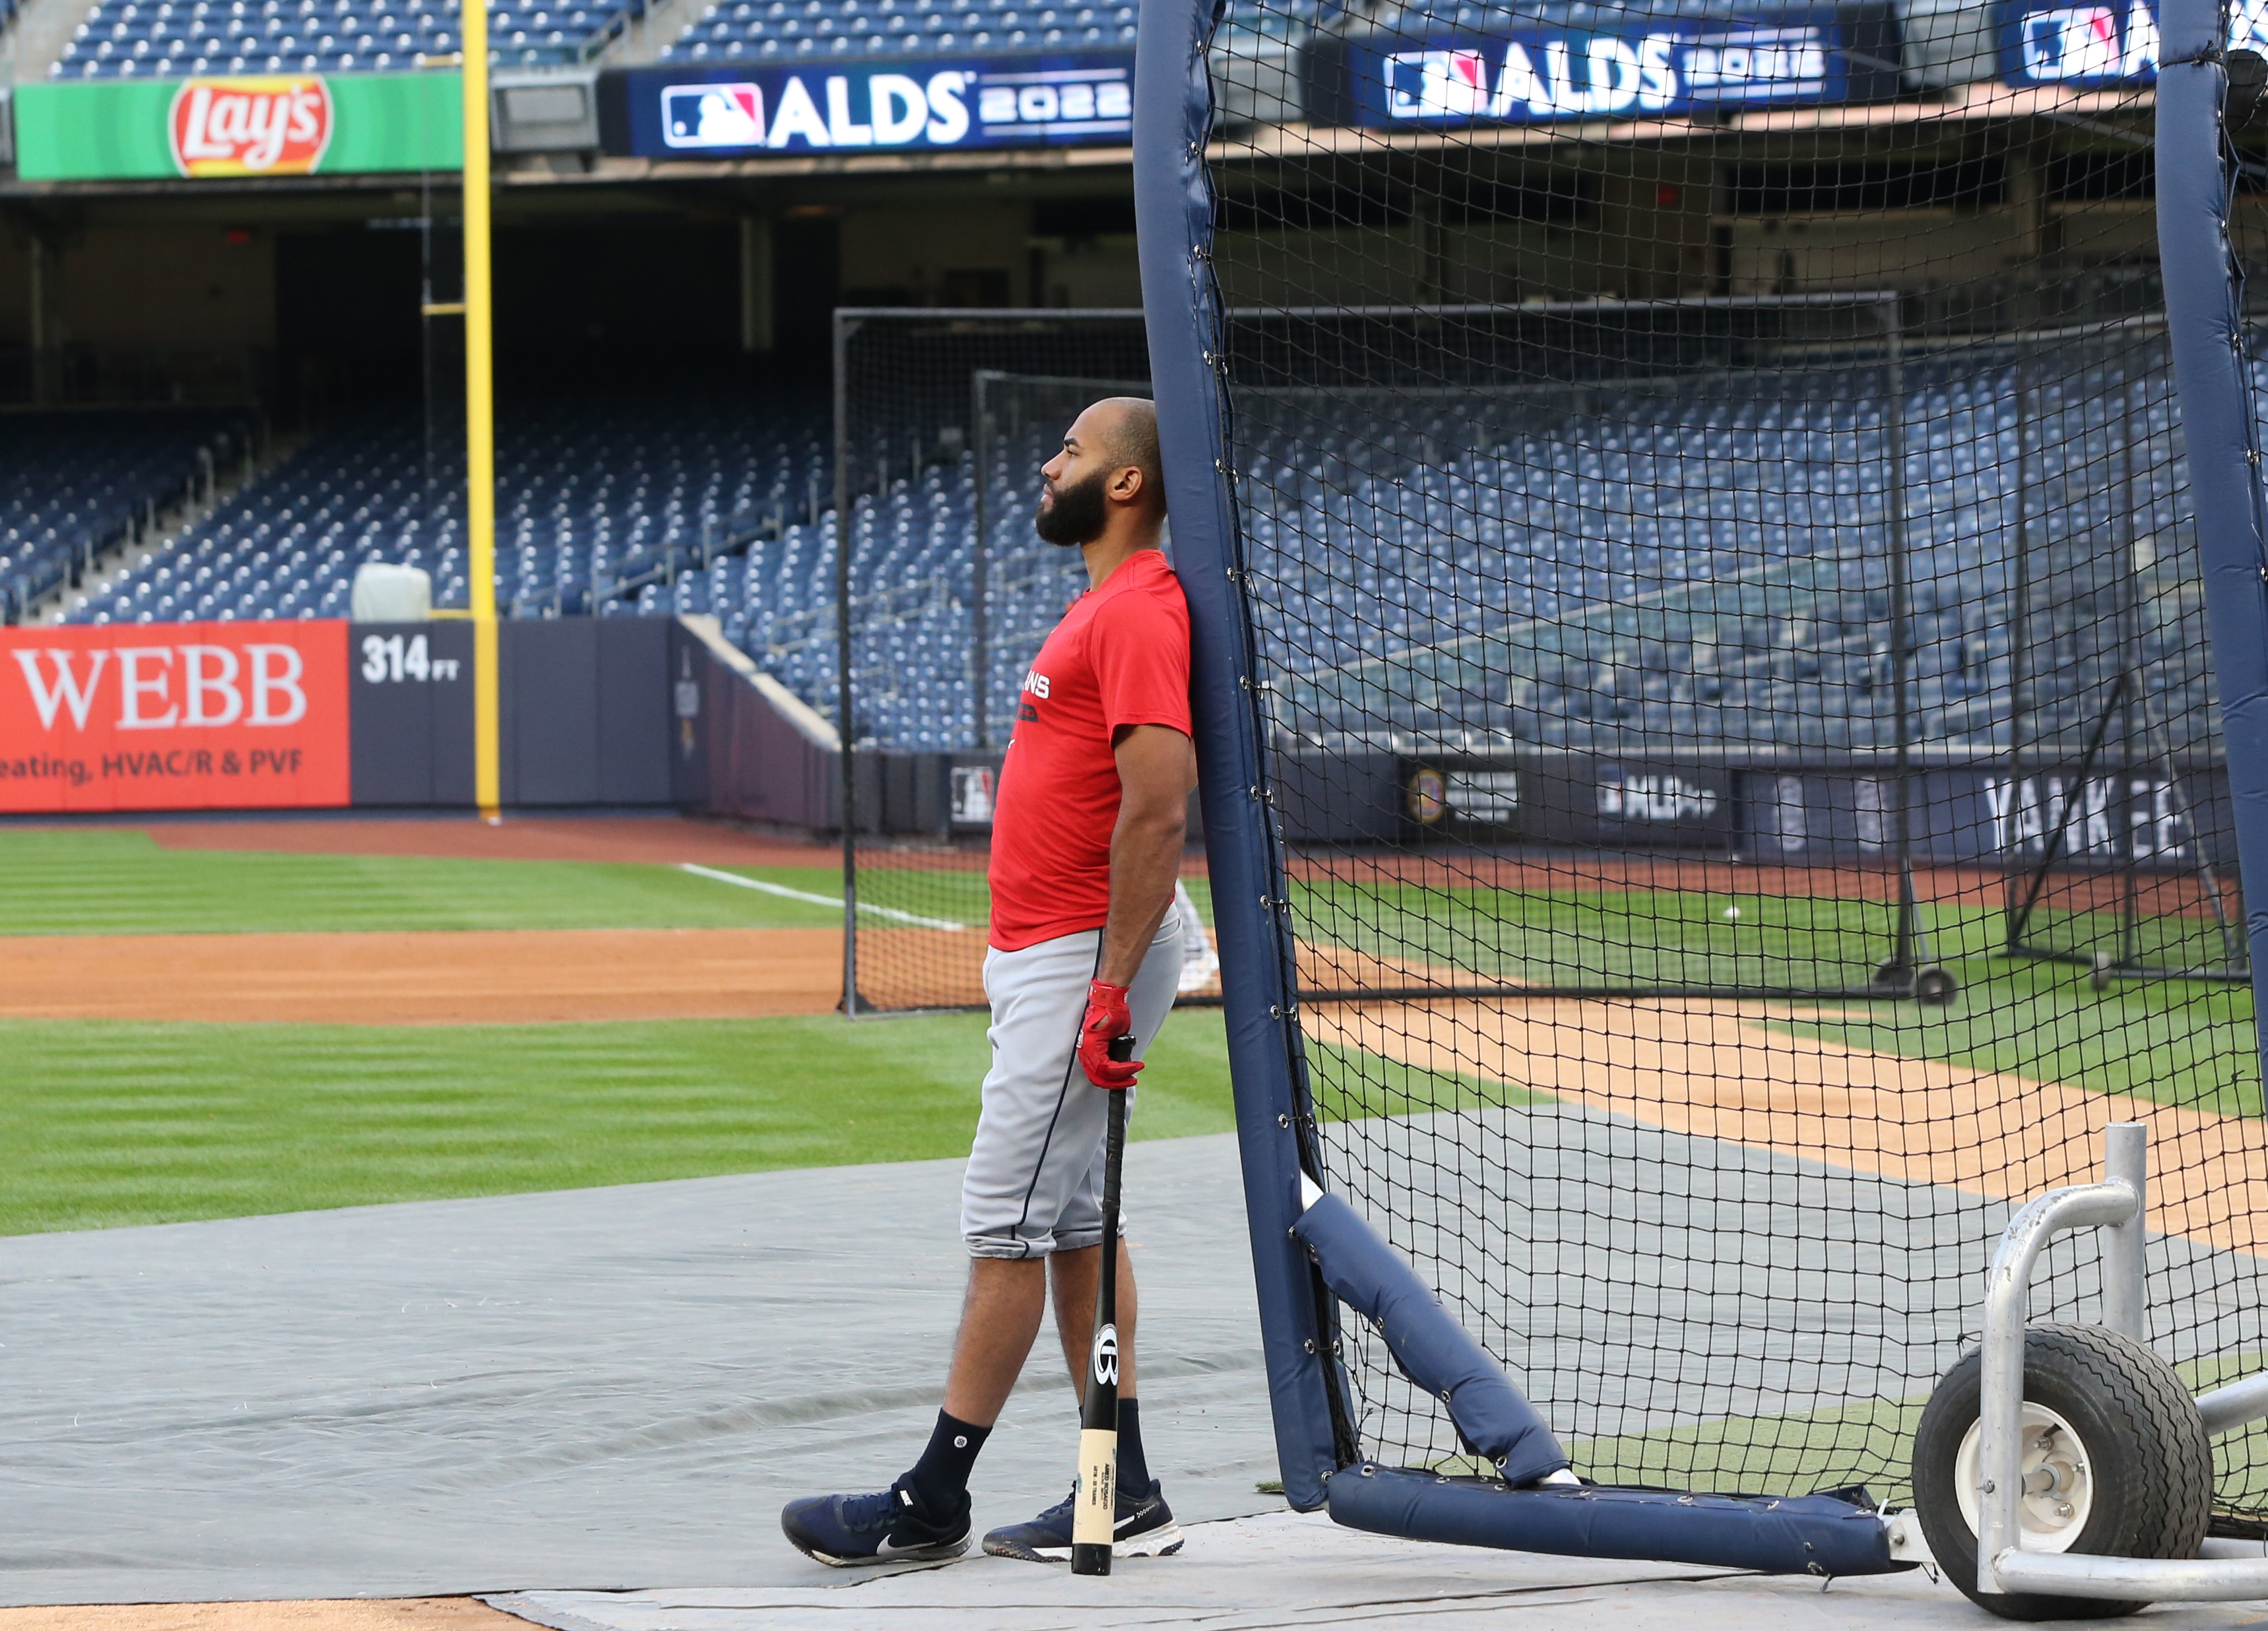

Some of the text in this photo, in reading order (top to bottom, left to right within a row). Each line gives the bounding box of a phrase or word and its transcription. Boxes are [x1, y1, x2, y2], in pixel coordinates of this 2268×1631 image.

[766, 71, 1132, 148] ALDS 2022
[1489, 32, 1678, 117] ALDS
[183, 83, 322, 171] Lay's
[11, 643, 308, 732] WEBB
[361, 633, 463, 684] 314 FT
[102, 748, 214, 779] HVAC/R
[222, 749, 242, 775] &
[250, 748, 303, 775] PVF
